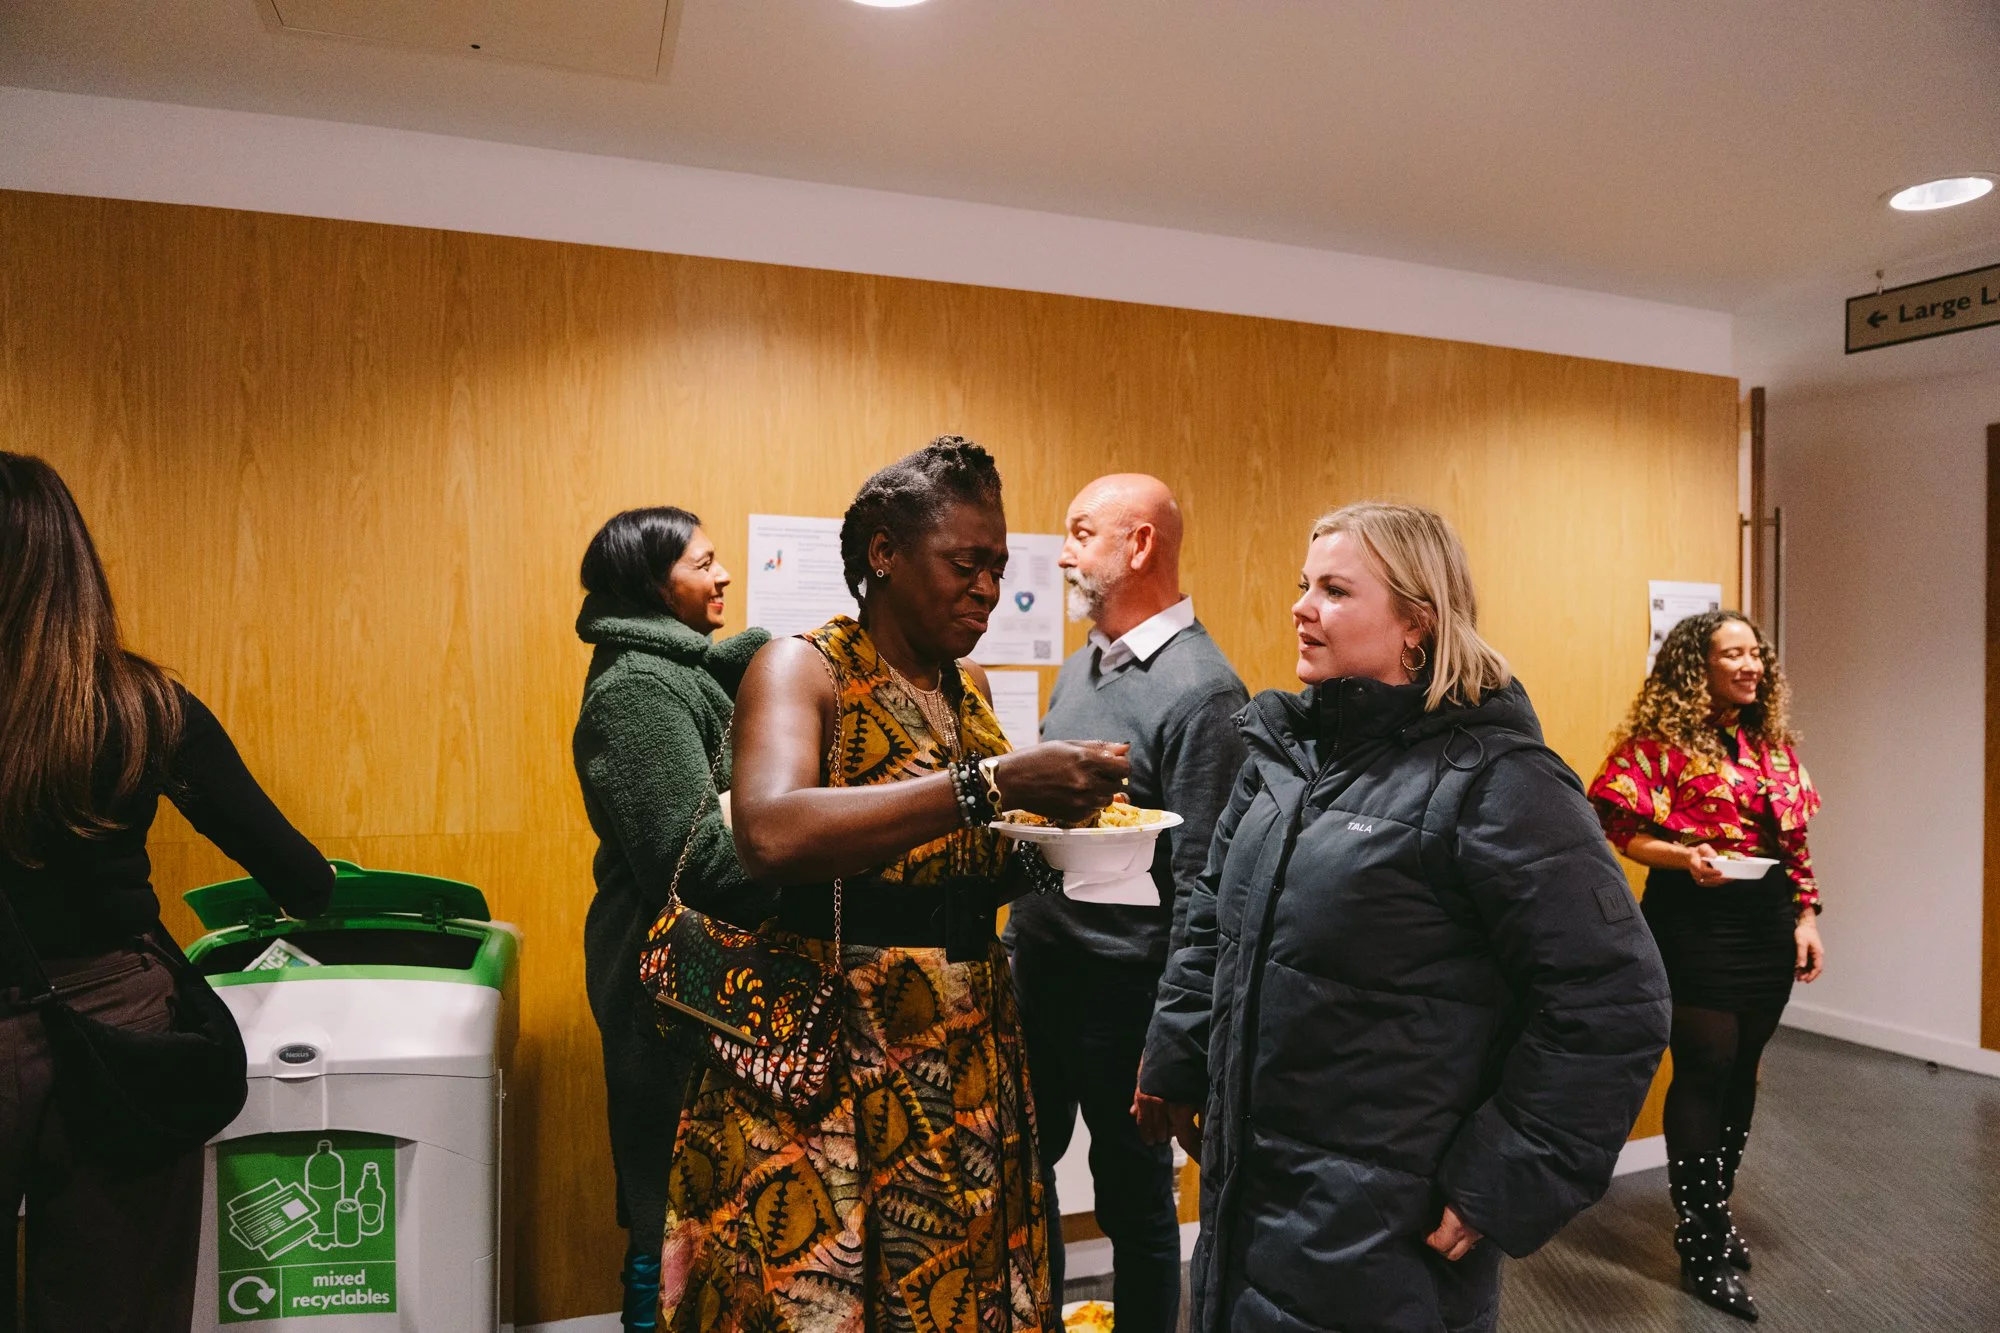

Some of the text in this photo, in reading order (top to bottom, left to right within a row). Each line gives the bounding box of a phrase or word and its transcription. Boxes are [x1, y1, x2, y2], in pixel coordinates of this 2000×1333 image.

[1899, 286, 2000, 319] Large L
[1347, 822, 1372, 834] TALA
[313, 1269, 365, 1287] mixed
[292, 1288, 390, 1310] recyclables
